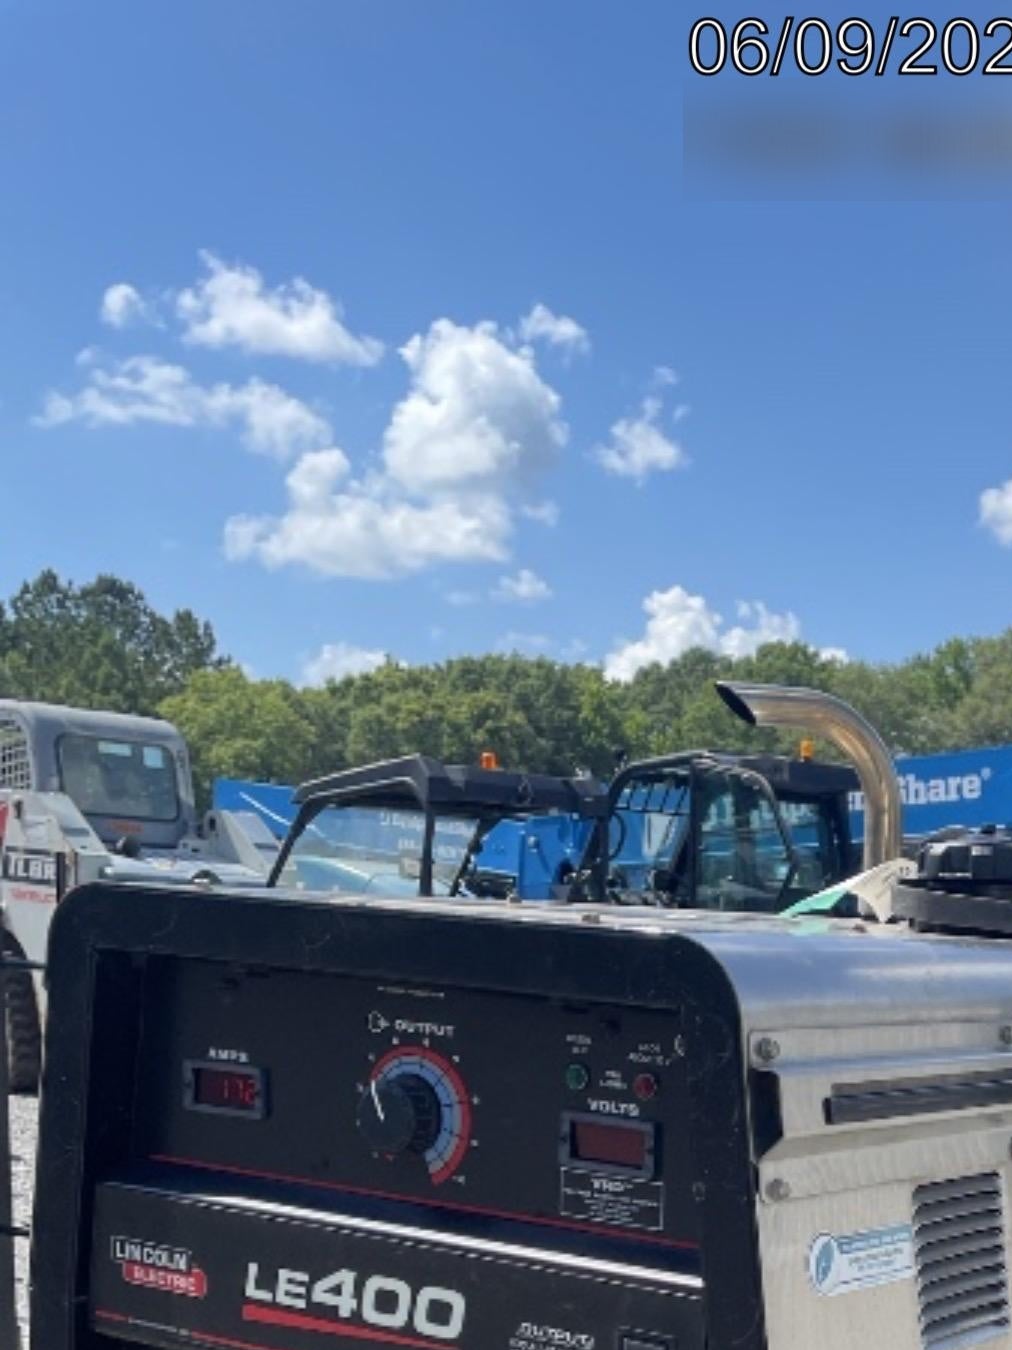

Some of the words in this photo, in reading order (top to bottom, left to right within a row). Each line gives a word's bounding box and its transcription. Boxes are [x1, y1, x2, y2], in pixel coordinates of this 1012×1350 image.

[394, 1018, 455, 1037] OUTPUT
[208, 1046, 250, 1063] AMPS
[587, 1098, 640, 1117] VOLTS
[114, 1240, 188, 1272] LINCOLN
[132, 1269, 197, 1292] ELECTRIC
[245, 1262, 466, 1340] LE400
